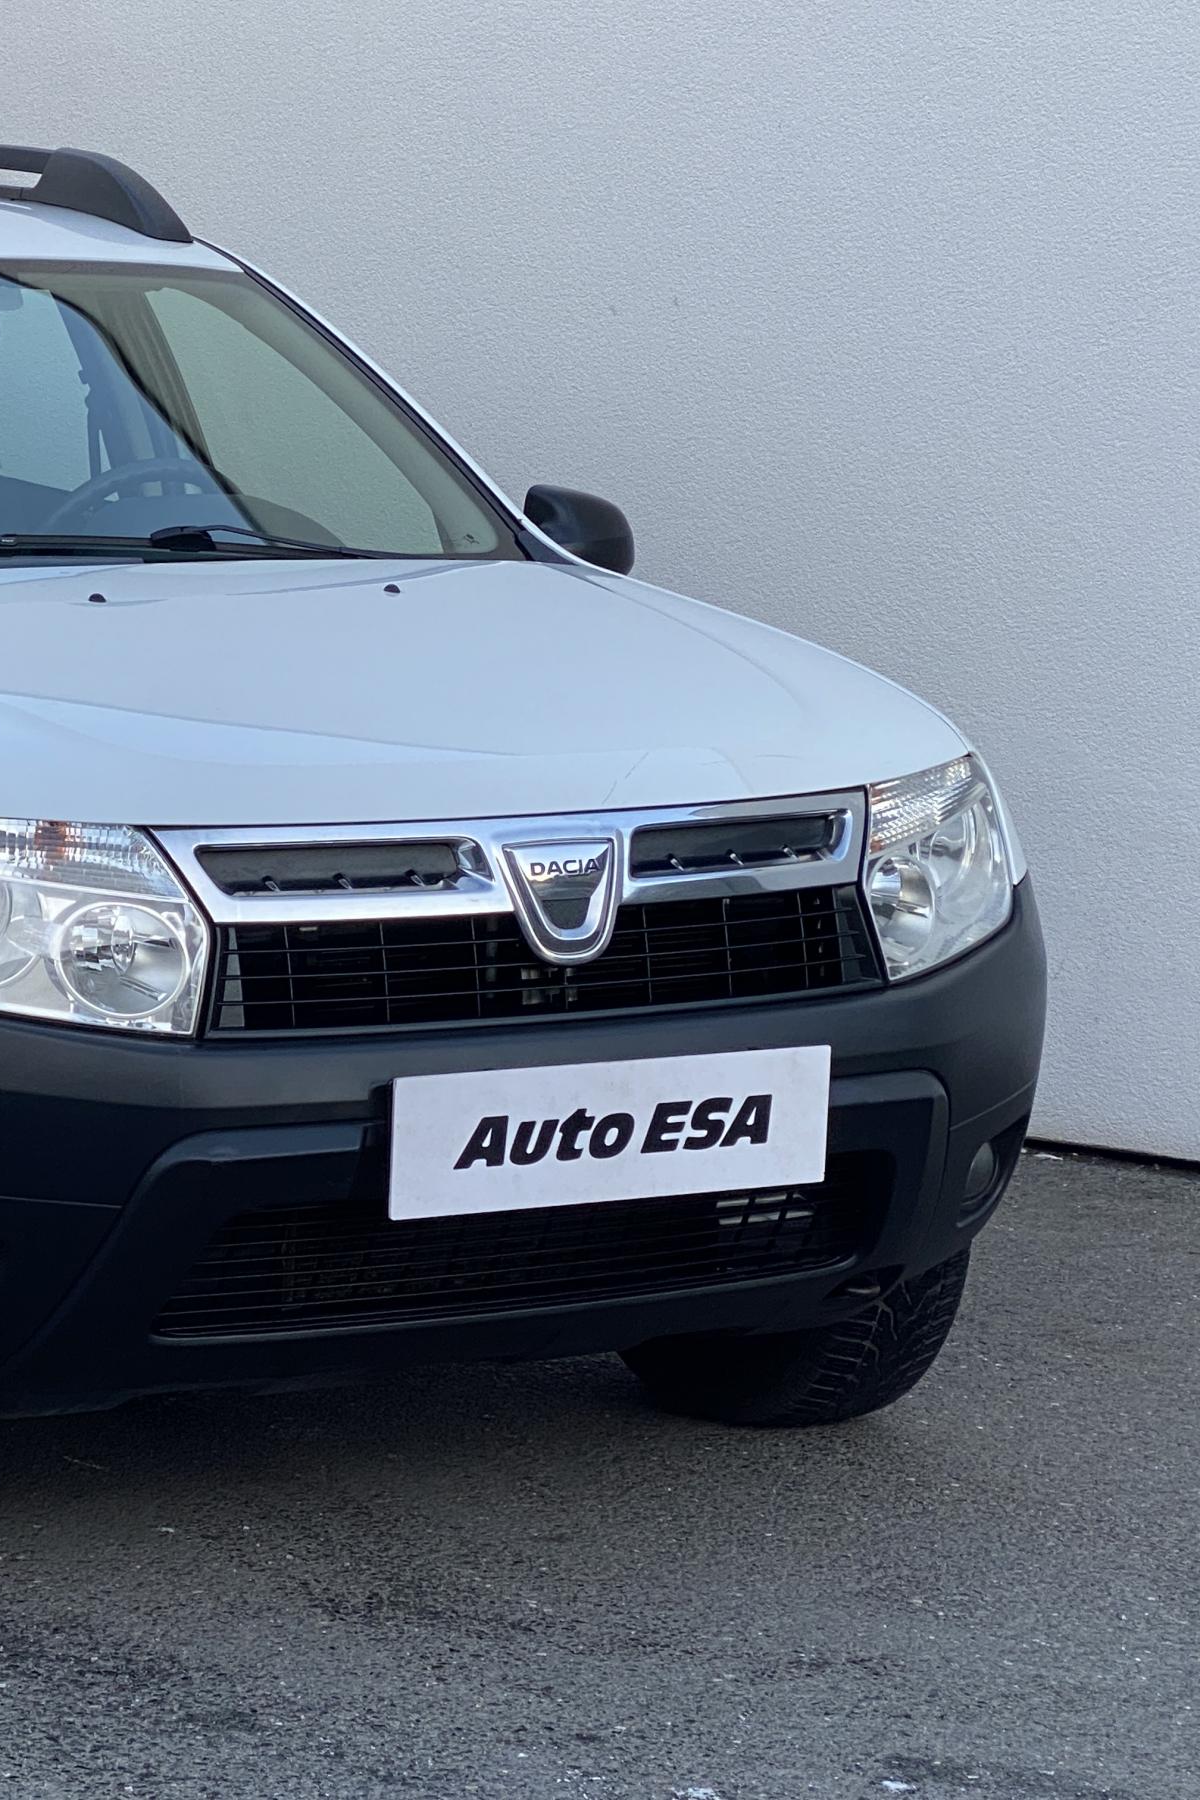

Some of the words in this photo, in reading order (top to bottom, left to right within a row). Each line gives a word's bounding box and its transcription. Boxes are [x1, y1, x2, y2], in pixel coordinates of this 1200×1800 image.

[530, 858, 600, 876] DACIA
[452, 1107, 635, 1170] Auto
[640, 1093, 773, 1154] ESA
